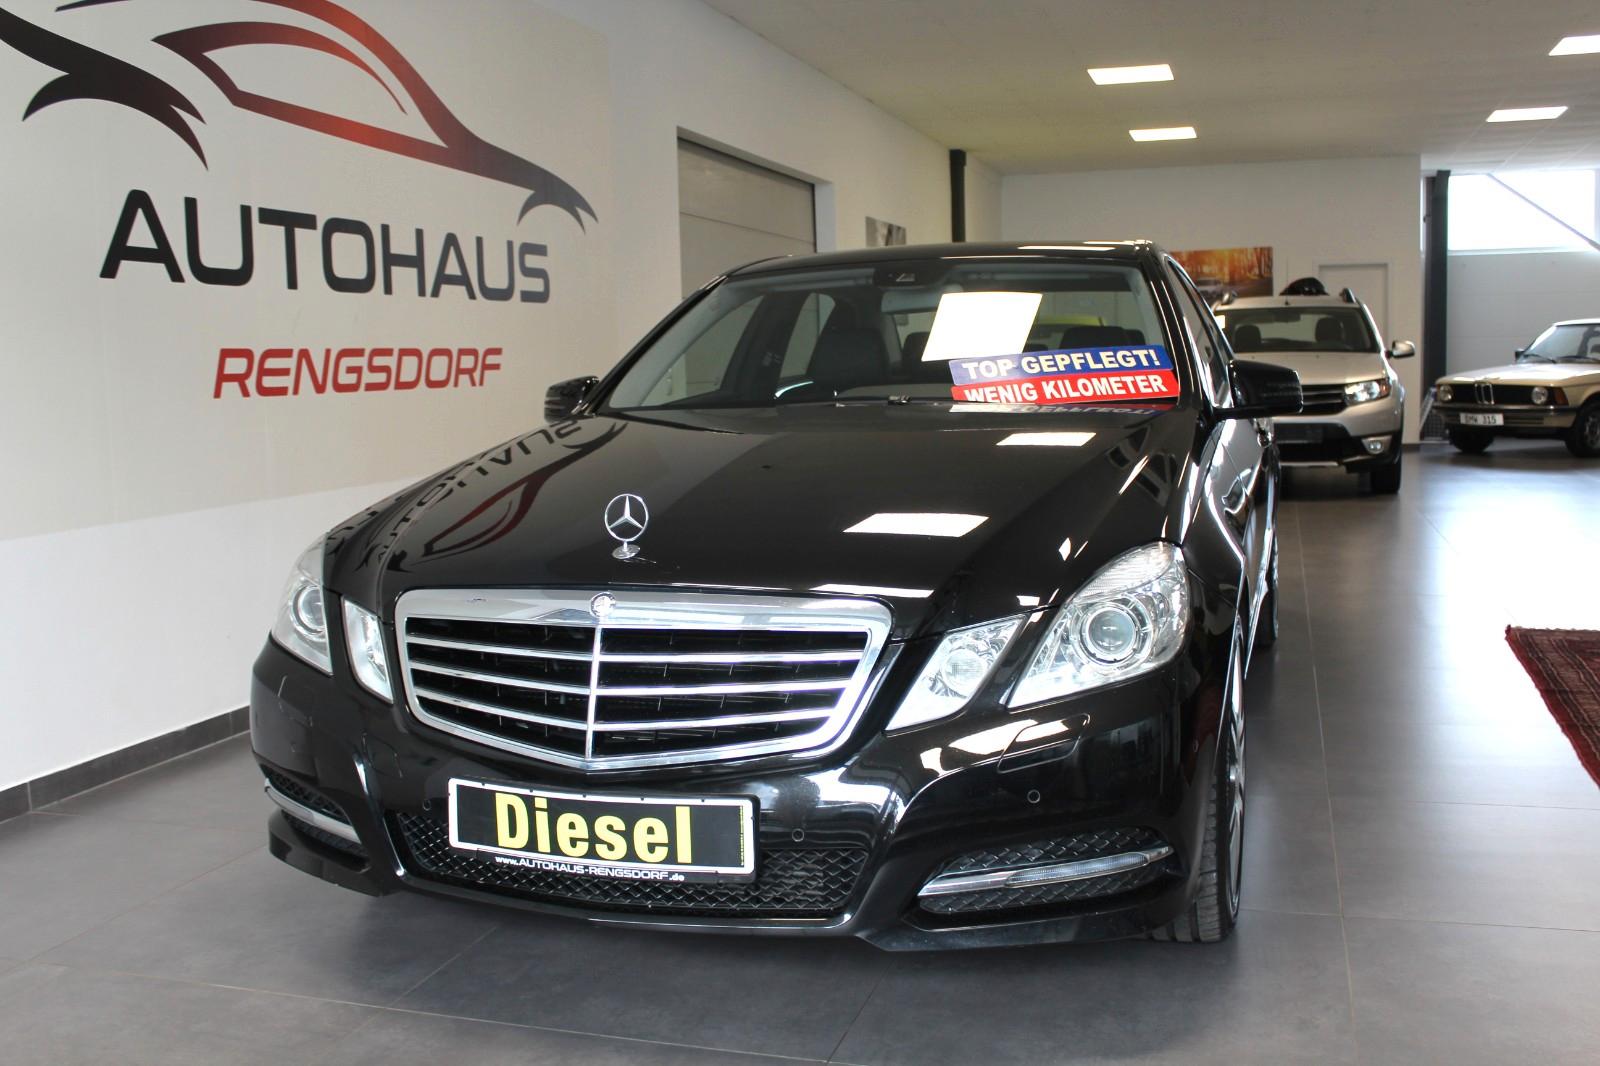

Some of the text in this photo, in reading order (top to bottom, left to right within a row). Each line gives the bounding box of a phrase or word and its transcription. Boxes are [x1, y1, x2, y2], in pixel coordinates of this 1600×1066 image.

[99, 188, 550, 303] AUTOHAUS
[213, 347, 503, 398] RENGSDORF
[962, 349, 1161, 379] TOP GEPFLEGT!
[964, 375, 1168, 404] WENIG KILOMETER
[494, 792, 692, 864] Diesel
[495, 855, 685, 882] www.AUTOHAUS-RENGSDORF.de
